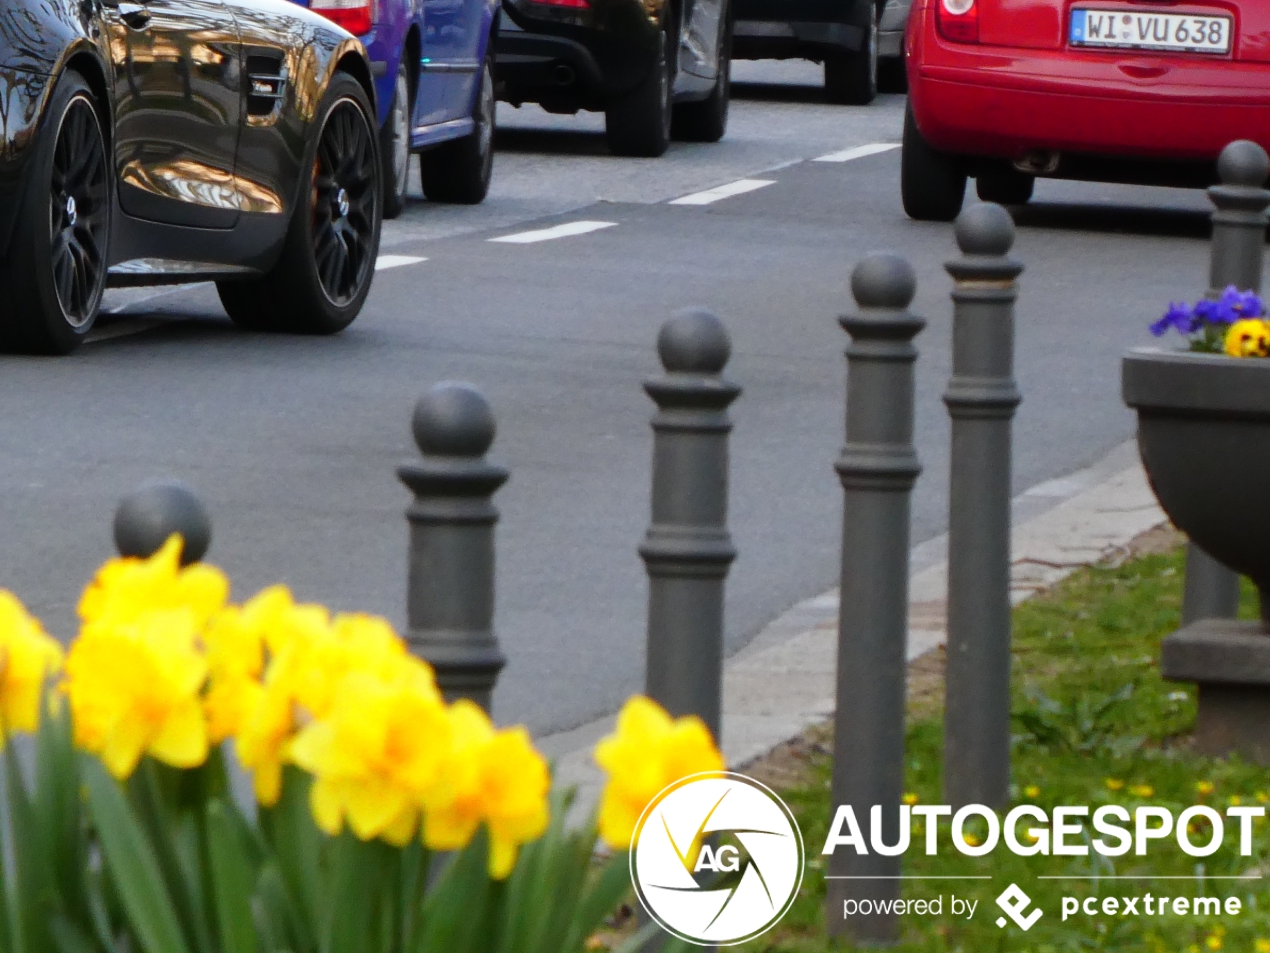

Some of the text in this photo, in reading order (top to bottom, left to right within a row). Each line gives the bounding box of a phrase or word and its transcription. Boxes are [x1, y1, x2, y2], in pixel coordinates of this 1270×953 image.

[1087, 14, 1223, 45] WI VU 638
